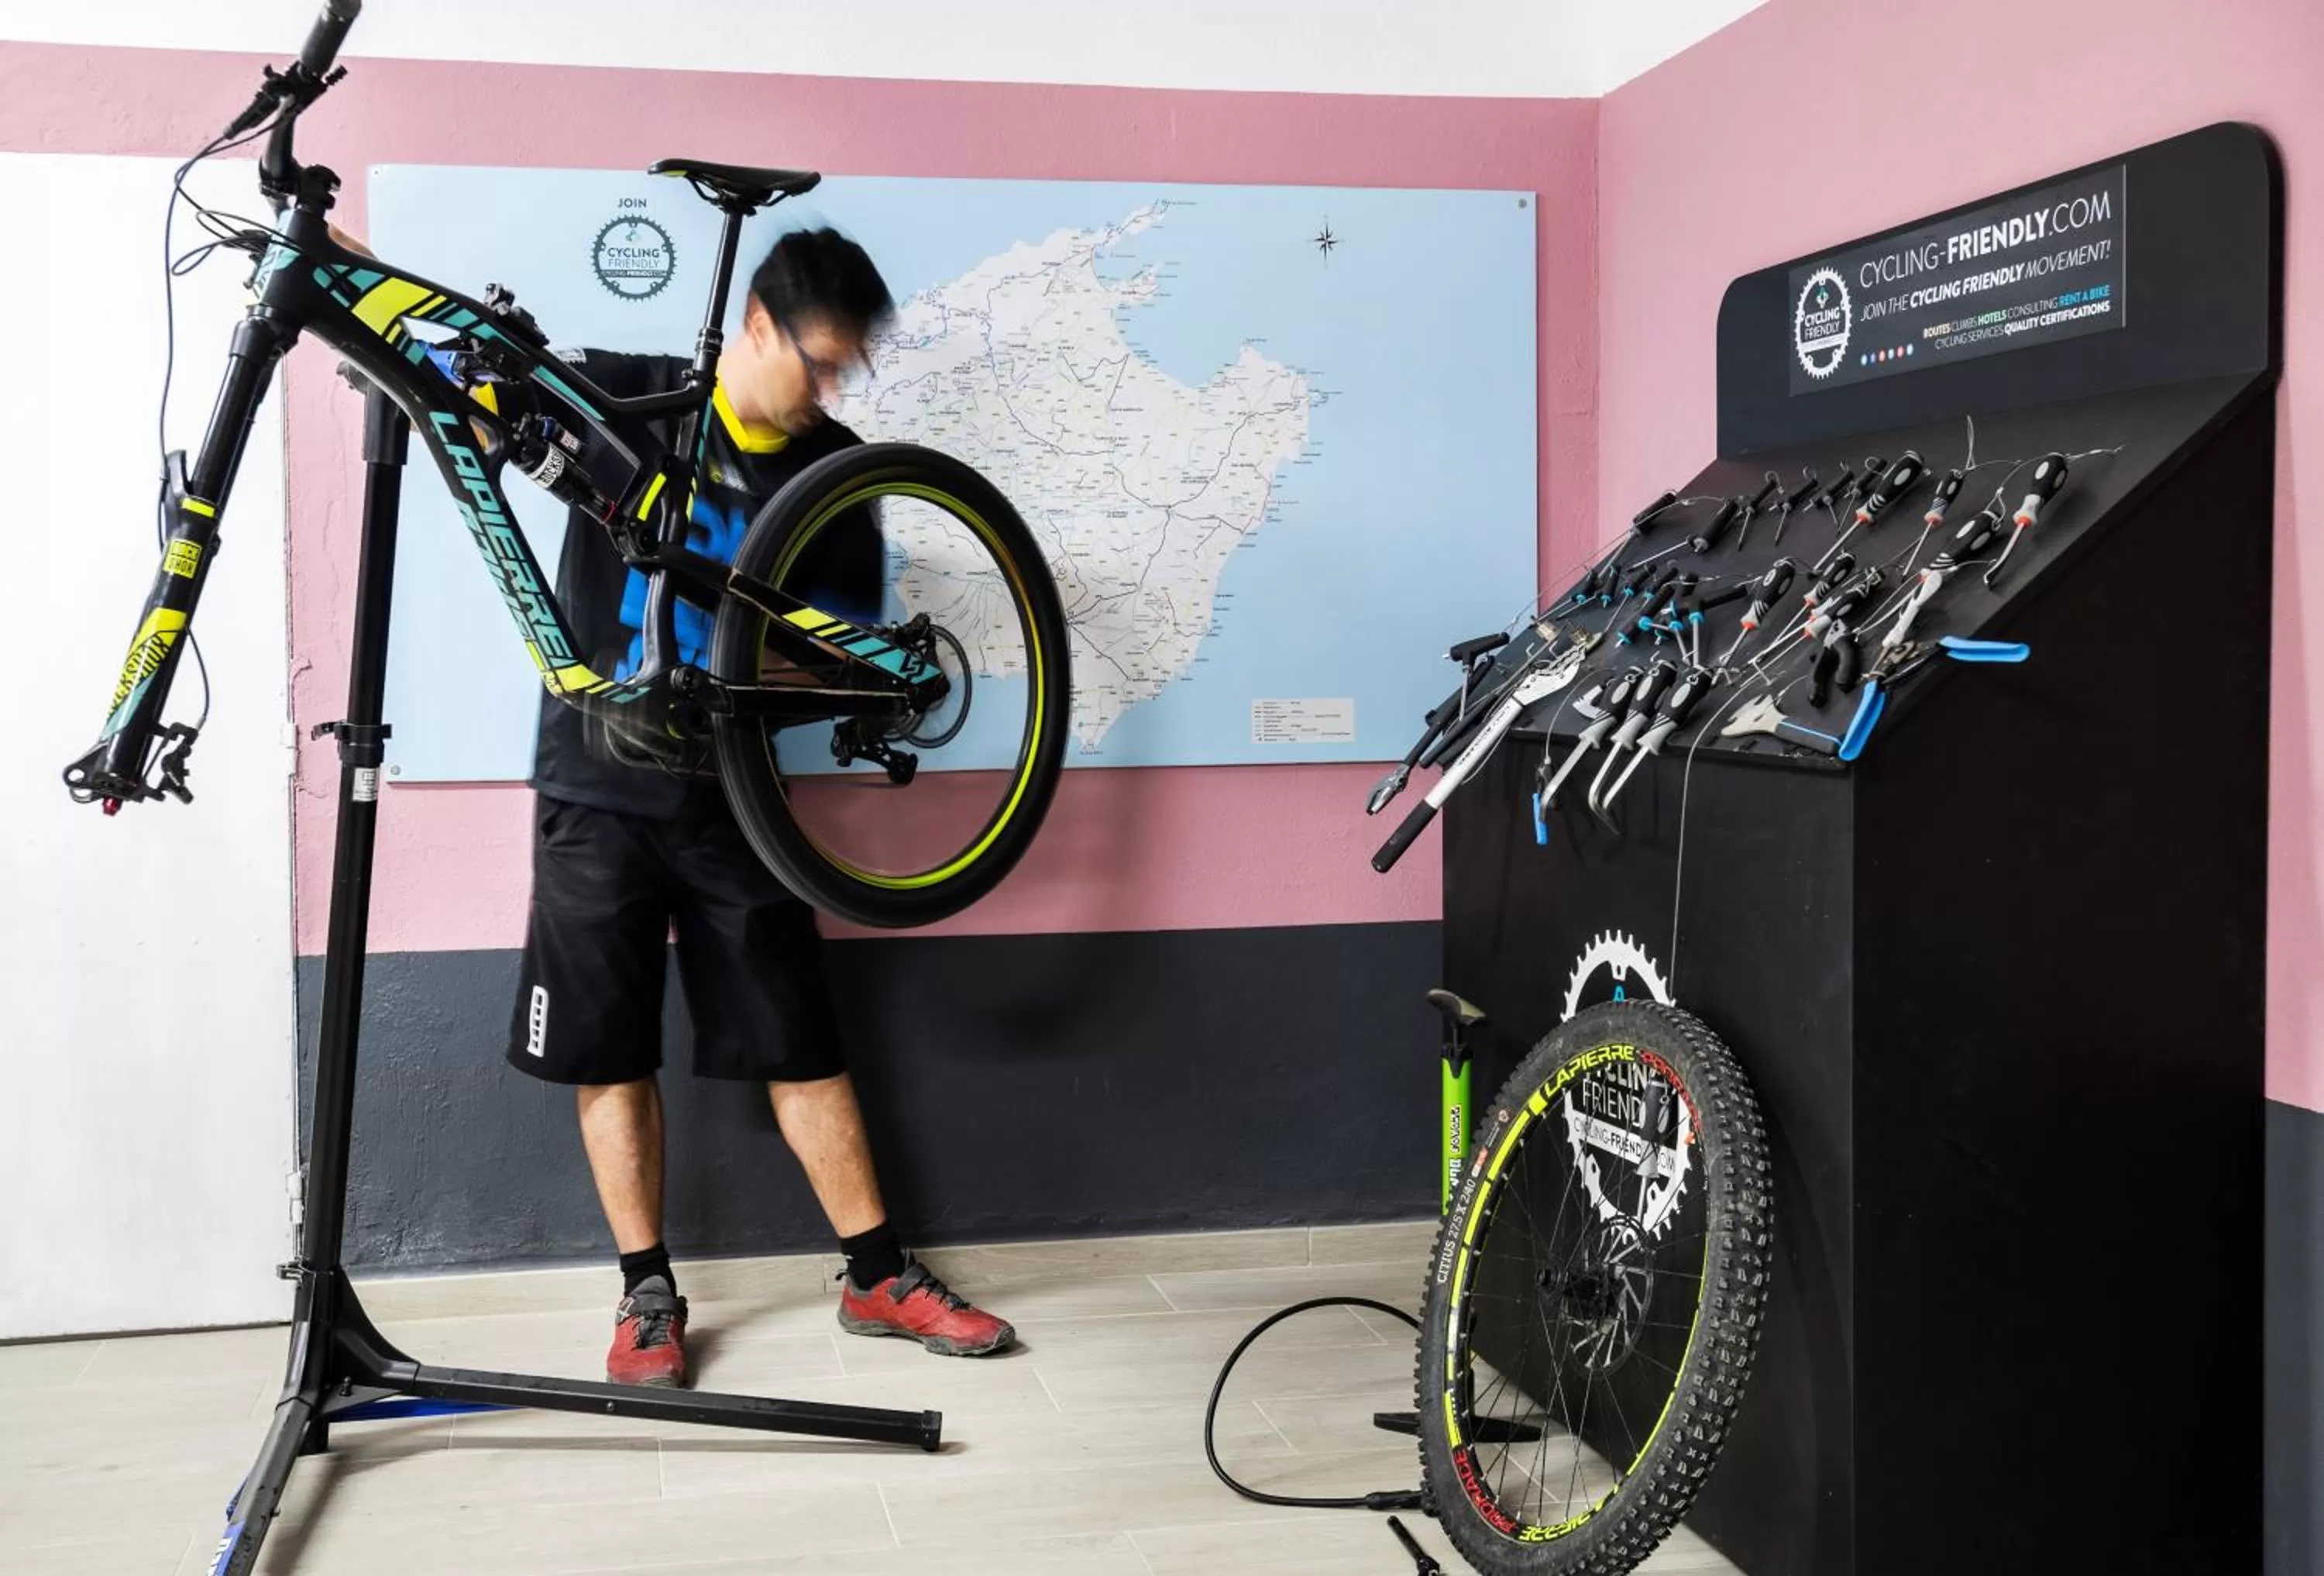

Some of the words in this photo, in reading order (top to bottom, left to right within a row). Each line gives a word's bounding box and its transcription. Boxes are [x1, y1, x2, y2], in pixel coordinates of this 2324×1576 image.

[617, 198, 647, 208] JOIN
[607, 247, 660, 258] CYCLING
[608, 258, 659, 269] FRIENDLY
[1860, 191, 2111, 288] CYCLING-FRIENDLY.COM
[1861, 301, 1886, 322] JOIN
[1888, 294, 1909, 314] THE
[1909, 280, 1961, 308] CYCLING
[1962, 262, 2025, 295] FRIENDLY
[2025, 239, 2111, 280] MOVEMENT!
[1804, 321, 1841, 340] FRIENDLY
[1805, 307, 1840, 327] CYCLING
[1923, 322, 1951, 339] ROUTES
[1978, 309, 2007, 325] HOTELS
[2007, 297, 2058, 319] CONSULTING
[2058, 291, 2082, 307] RENT
[2089, 284, 2111, 300] BIKE
[1935, 332, 1968, 350] CYCLING
[1968, 324, 2004, 342] SERVICES
[2004, 316, 2039, 336] QUALITY
[2040, 300, 2111, 326] CERTIFICATIONS
[429, 411, 580, 669] LAPIERRE
[1544, 1045, 1635, 1098] LAPIERRE
[1582, 1078, 1646, 1128] FRIEND
[1437, 1240, 1456, 1285] CITIUS
